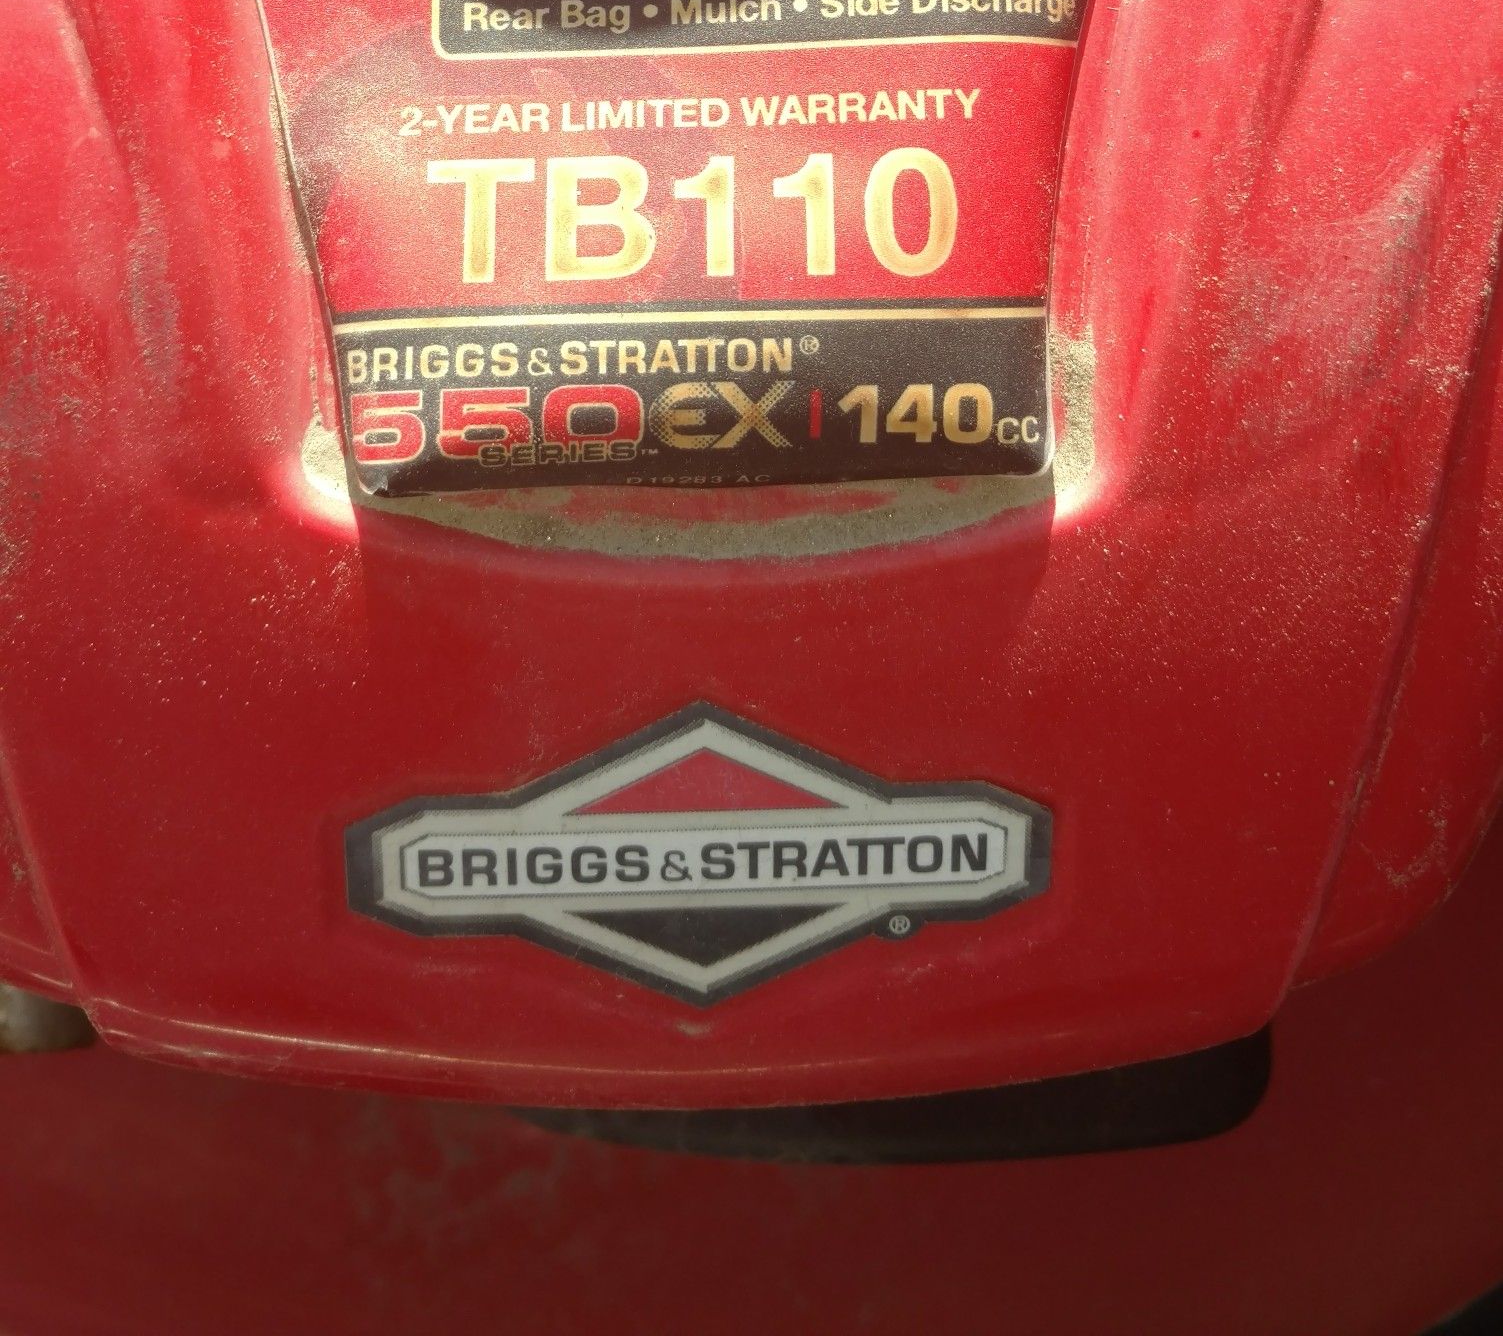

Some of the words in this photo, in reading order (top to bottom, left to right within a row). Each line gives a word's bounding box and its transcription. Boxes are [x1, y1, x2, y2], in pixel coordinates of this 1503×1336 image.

[463, 2, 550, 32] Rear
[560, 0, 632, 33] Bag
[399, 102, 551, 137] 2-YEAR
[561, 96, 731, 133] LIMITED
[741, 88, 981, 127] WARRANTY
[426, 146, 958, 284] TB110
[478, 439, 639, 468] SERIES
[736, 473, 772, 483] AC
